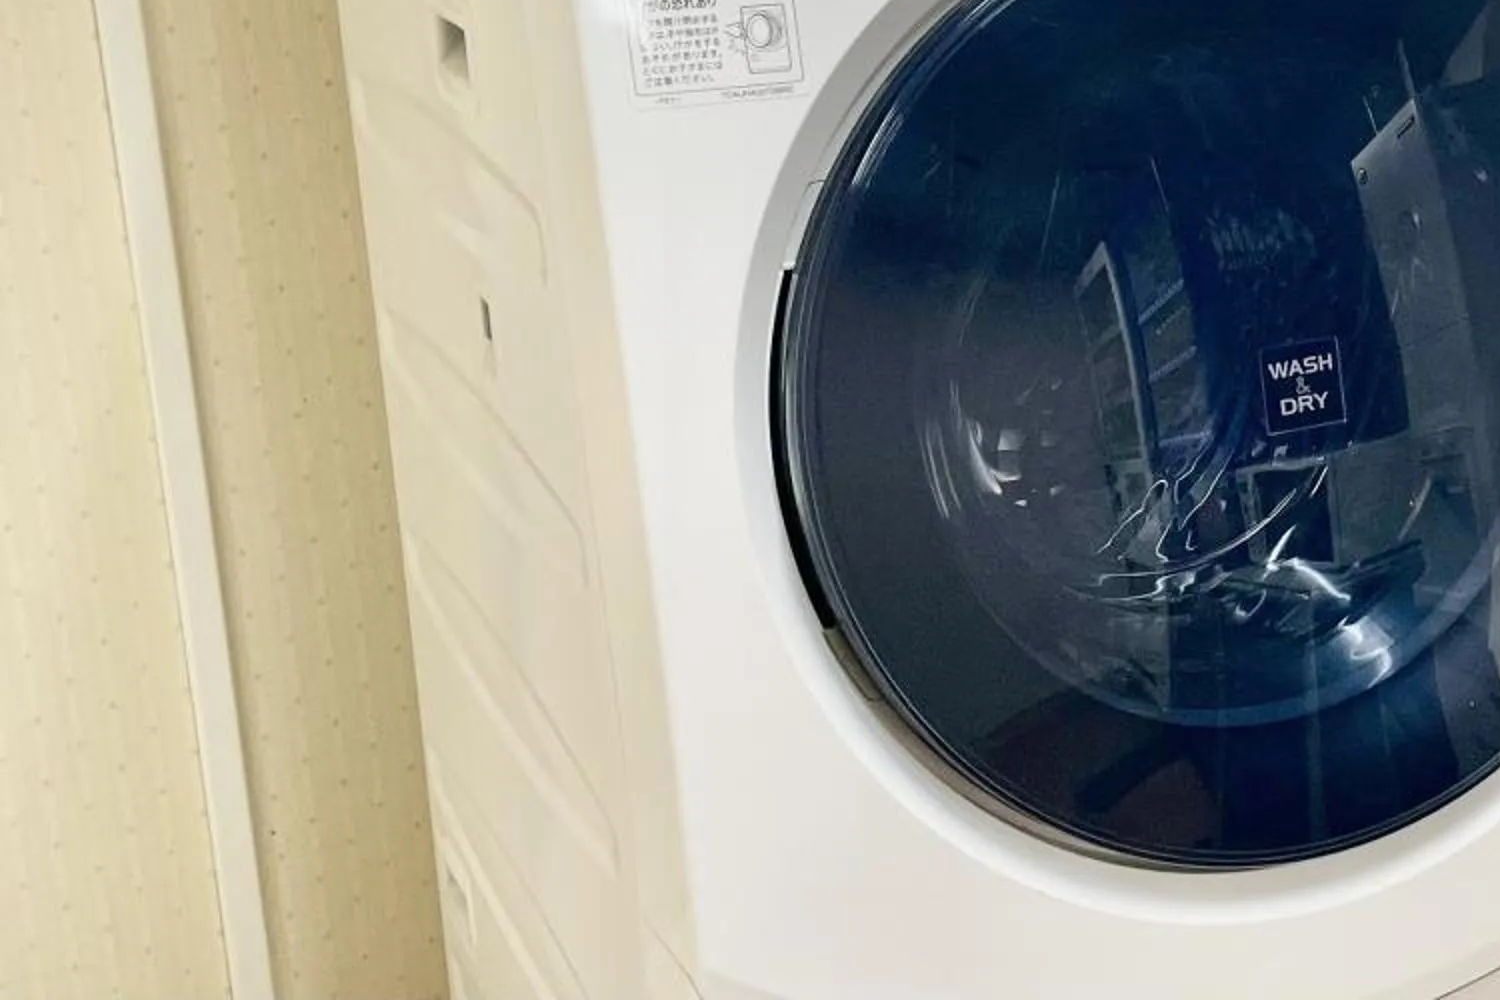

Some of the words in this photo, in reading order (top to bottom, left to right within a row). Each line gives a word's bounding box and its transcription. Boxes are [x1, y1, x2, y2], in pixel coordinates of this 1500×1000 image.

[1267, 352, 1333, 380] WASH
[1296, 376, 1311, 394] &
[1280, 391, 1328, 416] DRY
